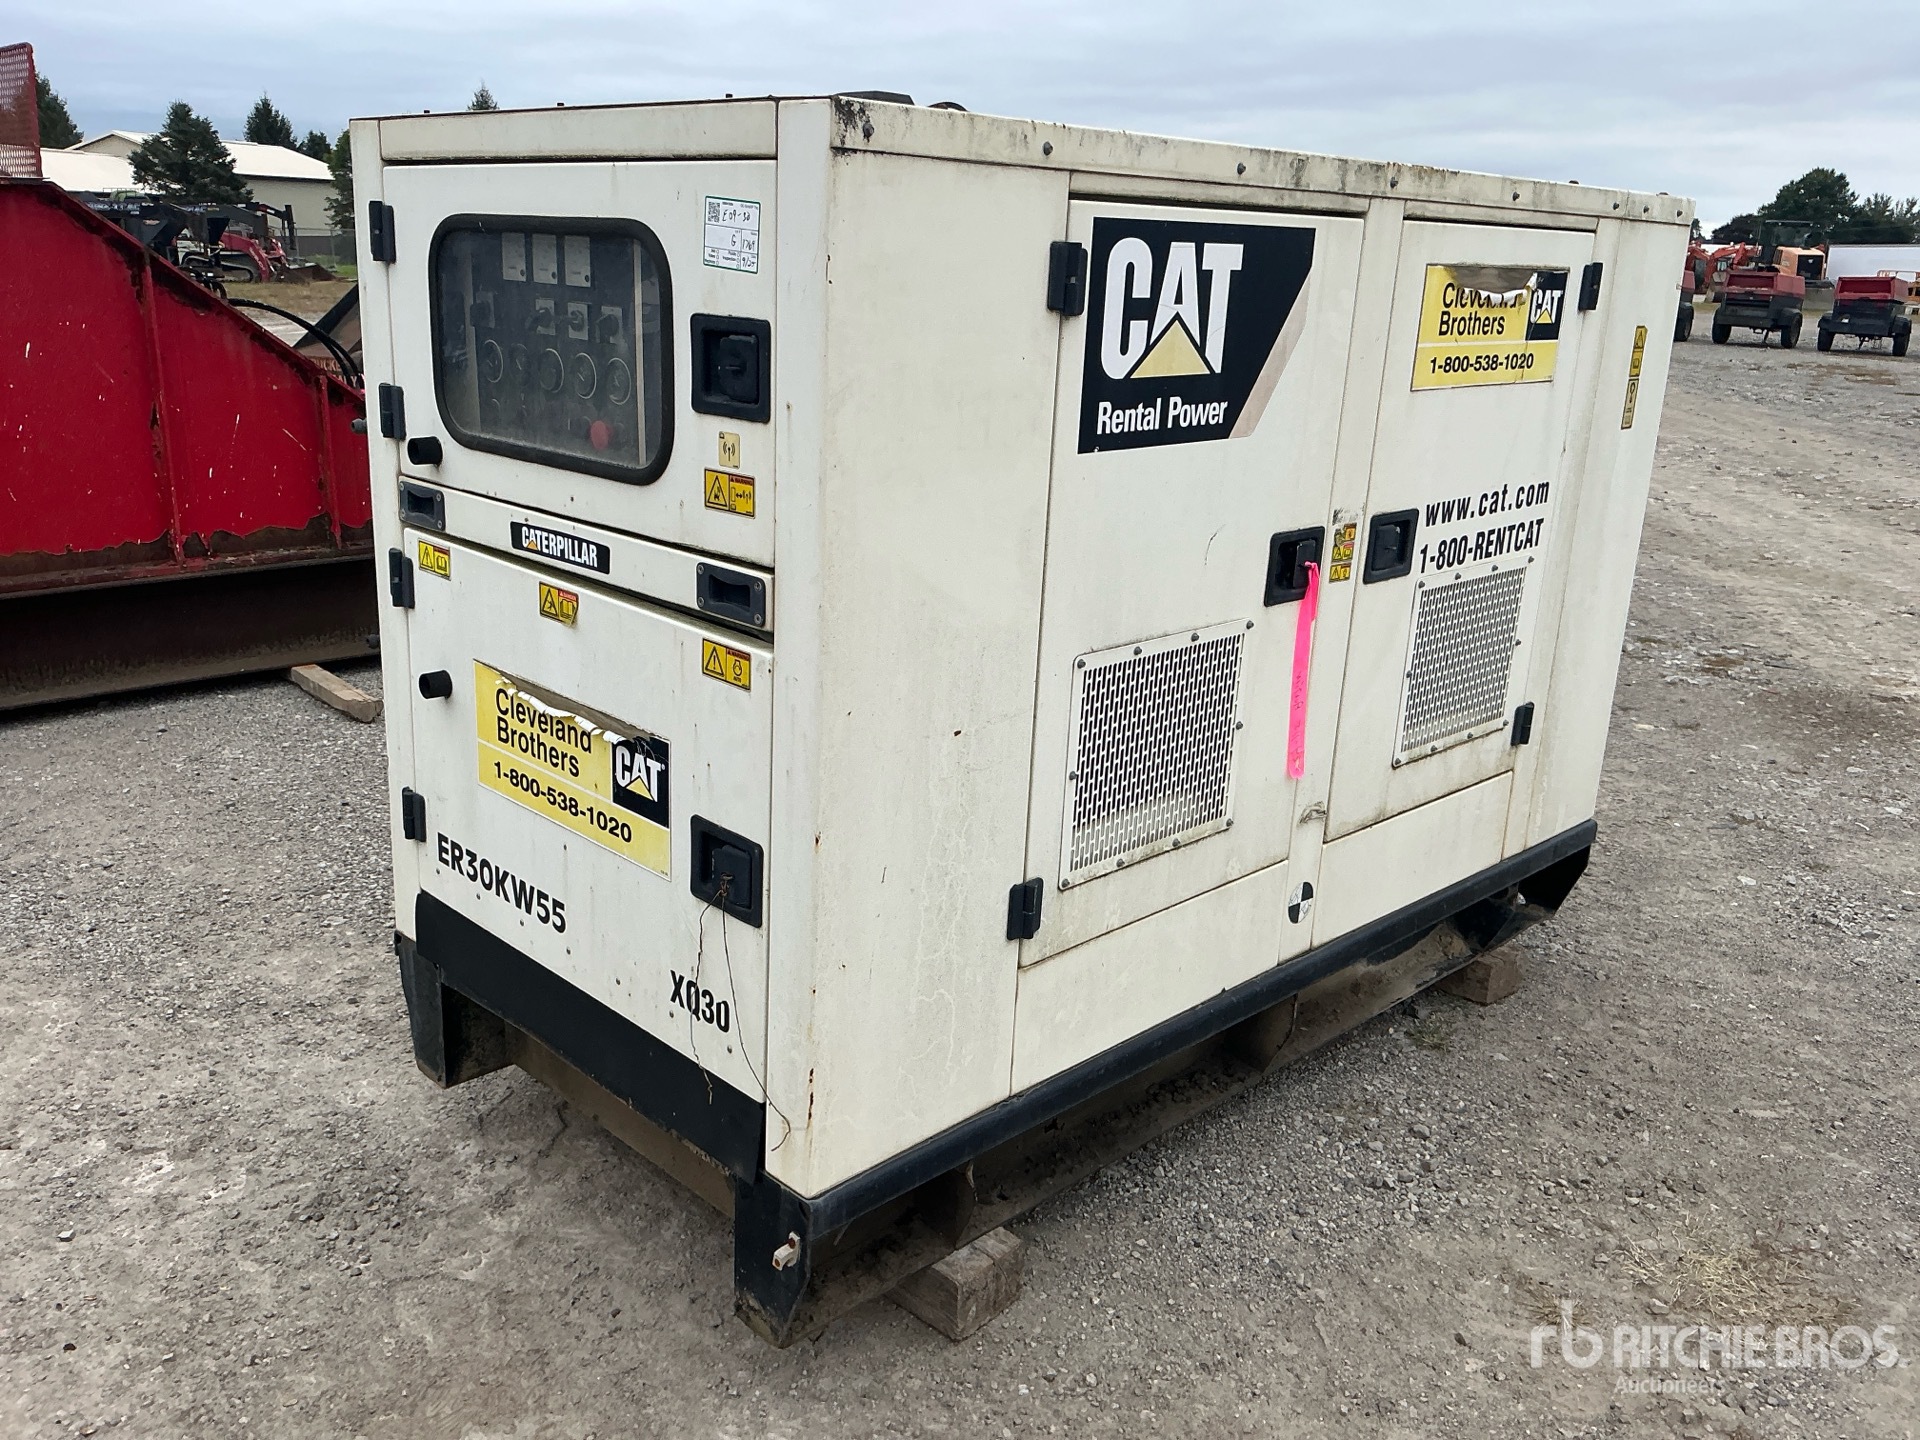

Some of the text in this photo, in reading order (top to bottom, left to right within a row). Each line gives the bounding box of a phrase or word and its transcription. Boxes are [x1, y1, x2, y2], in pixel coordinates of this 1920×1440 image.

[1100, 237, 1244, 380] CAT
[1438, 310, 1506, 336] Brothers
[1429, 353, 1534, 374] 1-800-538-1020
[1096, 396, 1228, 435] Rental Power
[1425, 481, 1550, 528] www.cat.com
[521, 526, 598, 568] CATERPILLAR
[1419, 517, 1545, 574] 1-800-RENTCAT
[496, 716, 580, 778] Brothers
[493, 761, 632, 843] 1-800-538-1020
[437, 832, 567, 933] ER30KW55
[669, 969, 730, 1033] XQ30
